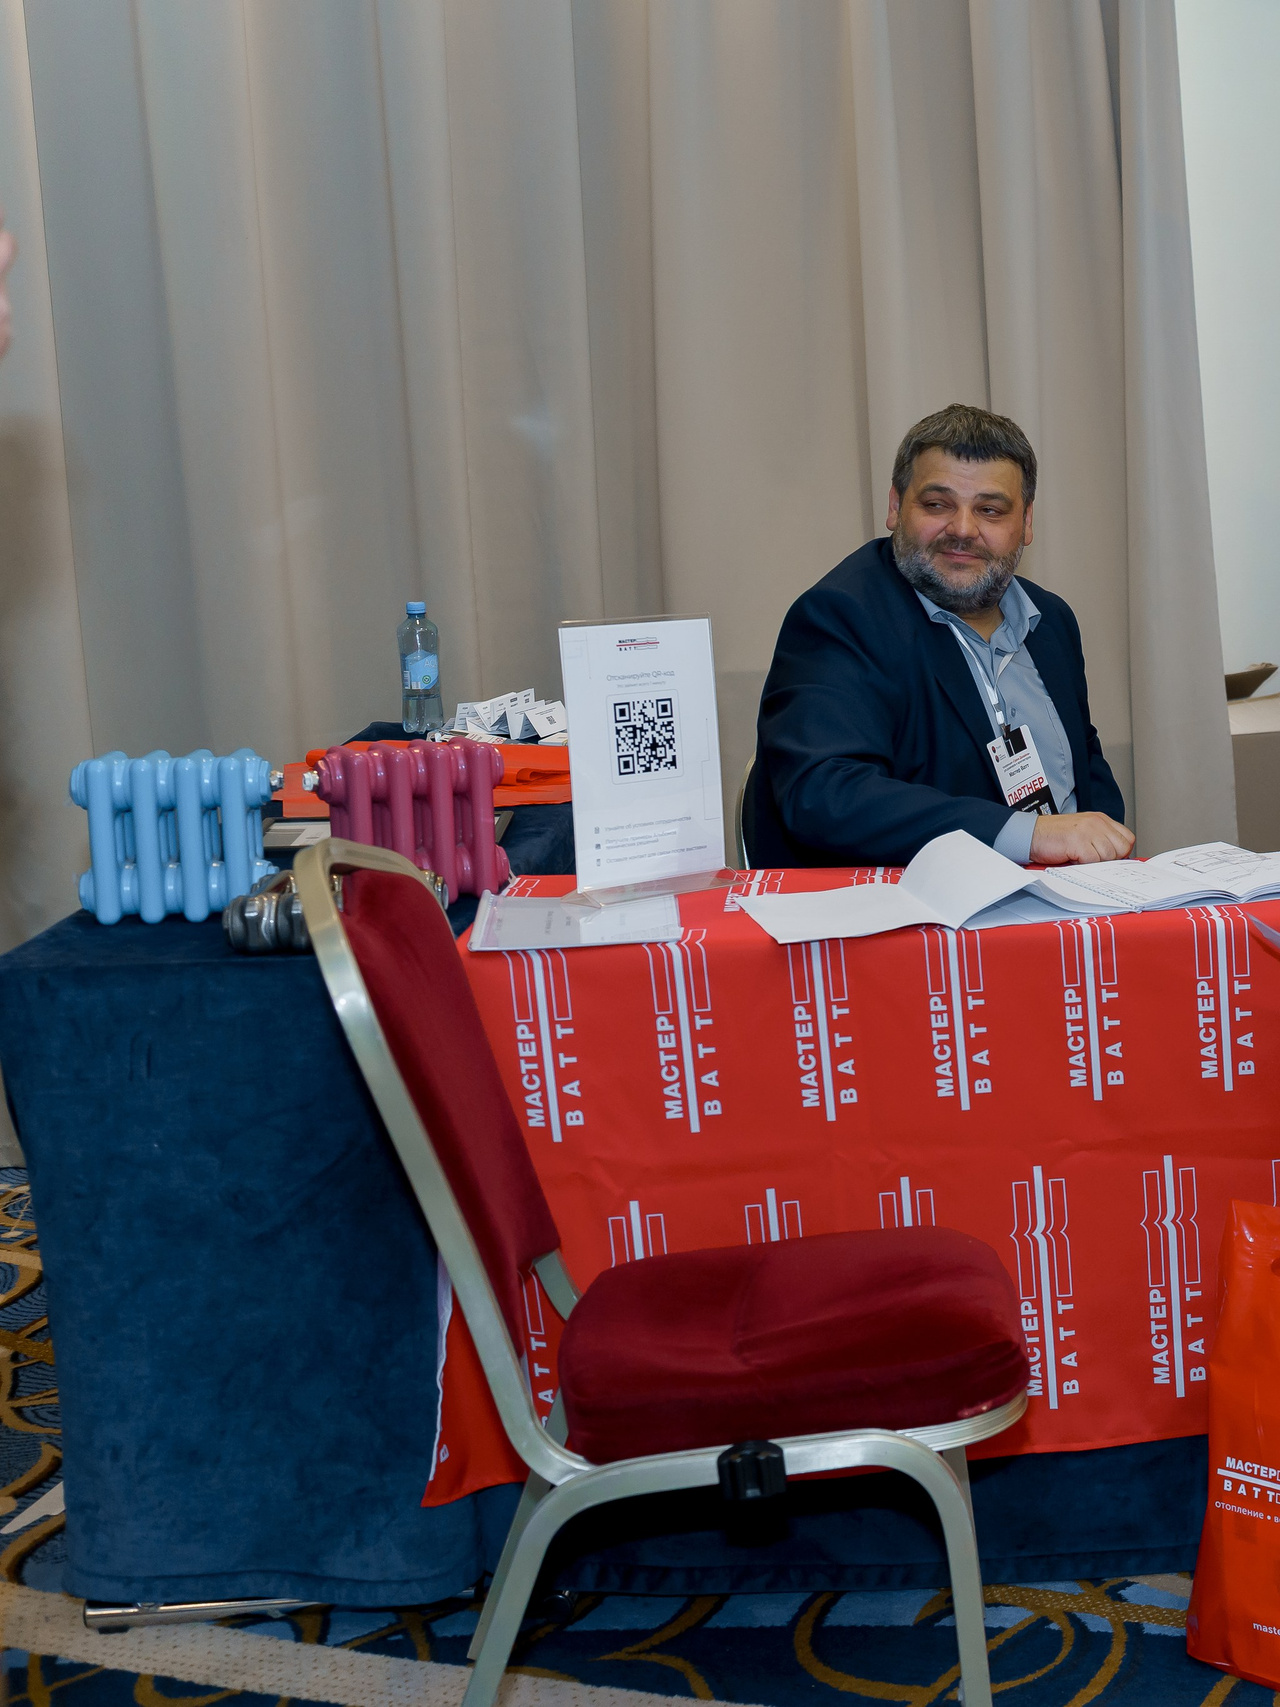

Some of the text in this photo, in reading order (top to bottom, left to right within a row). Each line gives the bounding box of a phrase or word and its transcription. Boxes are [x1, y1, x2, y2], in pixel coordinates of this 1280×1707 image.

[1008, 776, 1045, 805] ПАРТНЕР
[516, 1024, 545, 1127] МАСТЕР
[556, 1024, 584, 1126] ВАТТ
[656, 1016, 683, 1119] МАСТЕР
[695, 1015, 722, 1115] ВАТТ
[794, 1005, 820, 1107] МАСТЕР
[832, 1004, 858, 1103] ВАТТ
[930, 996, 954, 1096] МАСТЕР
[968, 996, 992, 1094] ВАТТ
[1065, 988, 1087, 1087] МАСТЕР
[1102, 988, 1124, 1085] ВАТТ
[1197, 980, 1219, 1079] МАСТЕР
[1234, 980, 1255, 1075] ВАТТ
[1020, 1301, 1043, 1396] МАСТЕР
[1058, 1300, 1079, 1395] ВАТТ
[1150, 1289, 1170, 1384] МАСТЕР
[1186, 1288, 1206, 1381] ВАТТ
[1215, 1501, 1264, 1520] отопление
[1224, 1479, 1275, 1503] ВАТТ
[1226, 1456, 1277, 1479] МАСТЕР
